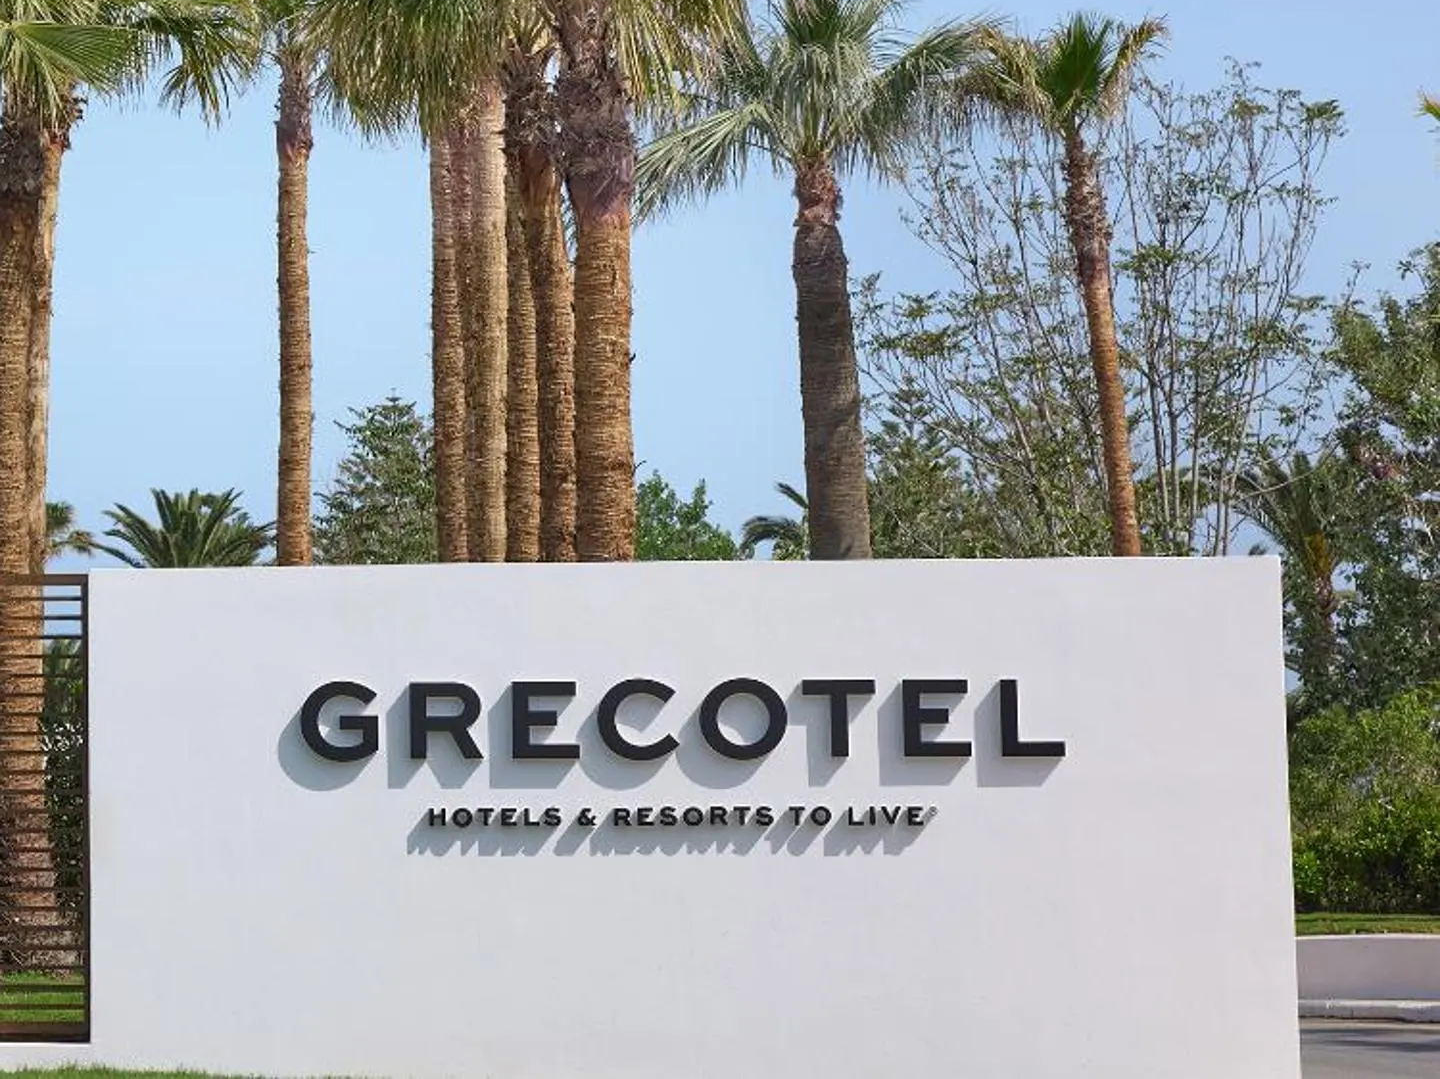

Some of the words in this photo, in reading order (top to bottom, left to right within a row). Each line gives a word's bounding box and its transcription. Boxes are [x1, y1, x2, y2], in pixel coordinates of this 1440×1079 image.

[298, 677, 1066, 763] GRECOTEL
[427, 806, 563, 828] HOTELS
[576, 806, 598, 829] &
[611, 805, 776, 828] RESORTS
[788, 805, 833, 828] TO
